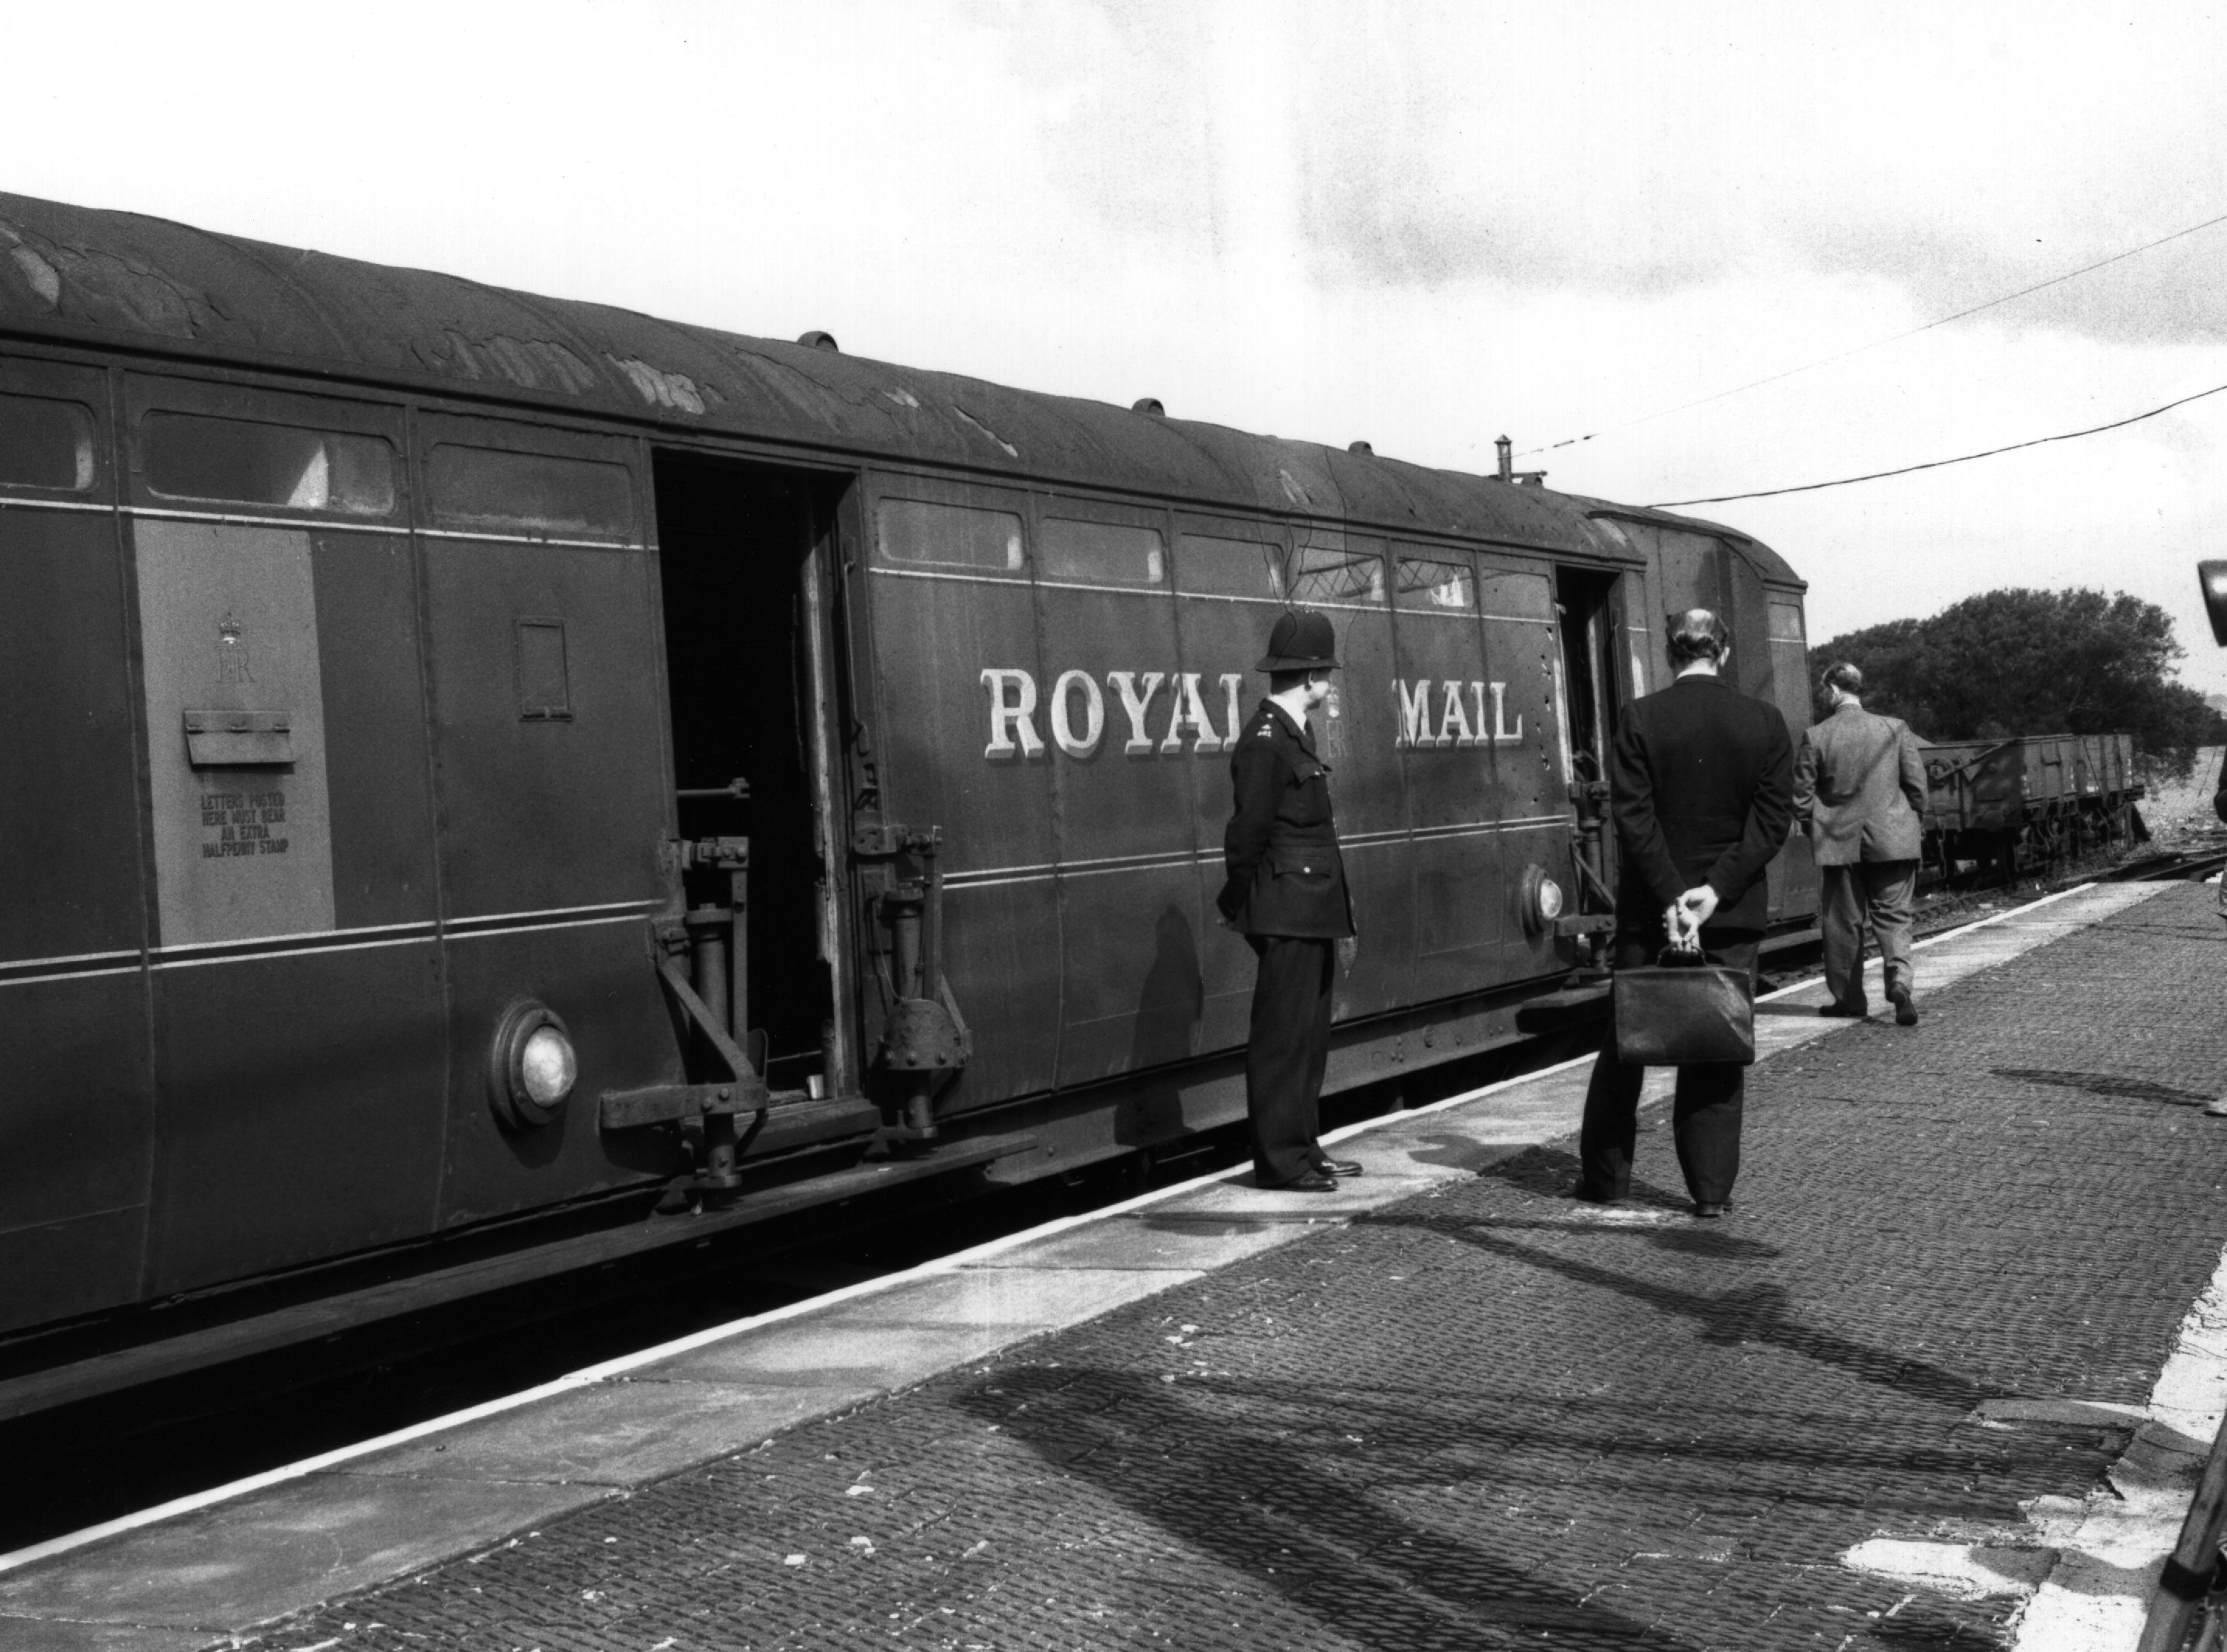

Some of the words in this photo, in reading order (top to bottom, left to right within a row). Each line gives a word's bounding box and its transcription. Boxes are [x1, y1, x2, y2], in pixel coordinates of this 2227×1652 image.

[1391, 678, 1523, 748] MAIL
[200, 793, 244, 810] LETTERS
[248, 792, 285, 808] POSTED
[202, 810, 228, 826] HERE
[231, 810, 256, 824] MUST
[261, 807, 287, 823] BEAR
[221, 825, 235, 841] AN
[239, 824, 269, 840] EXTRA
[202, 841, 255, 858] HALFPENNY
[259, 838, 290, 855] STAMP
